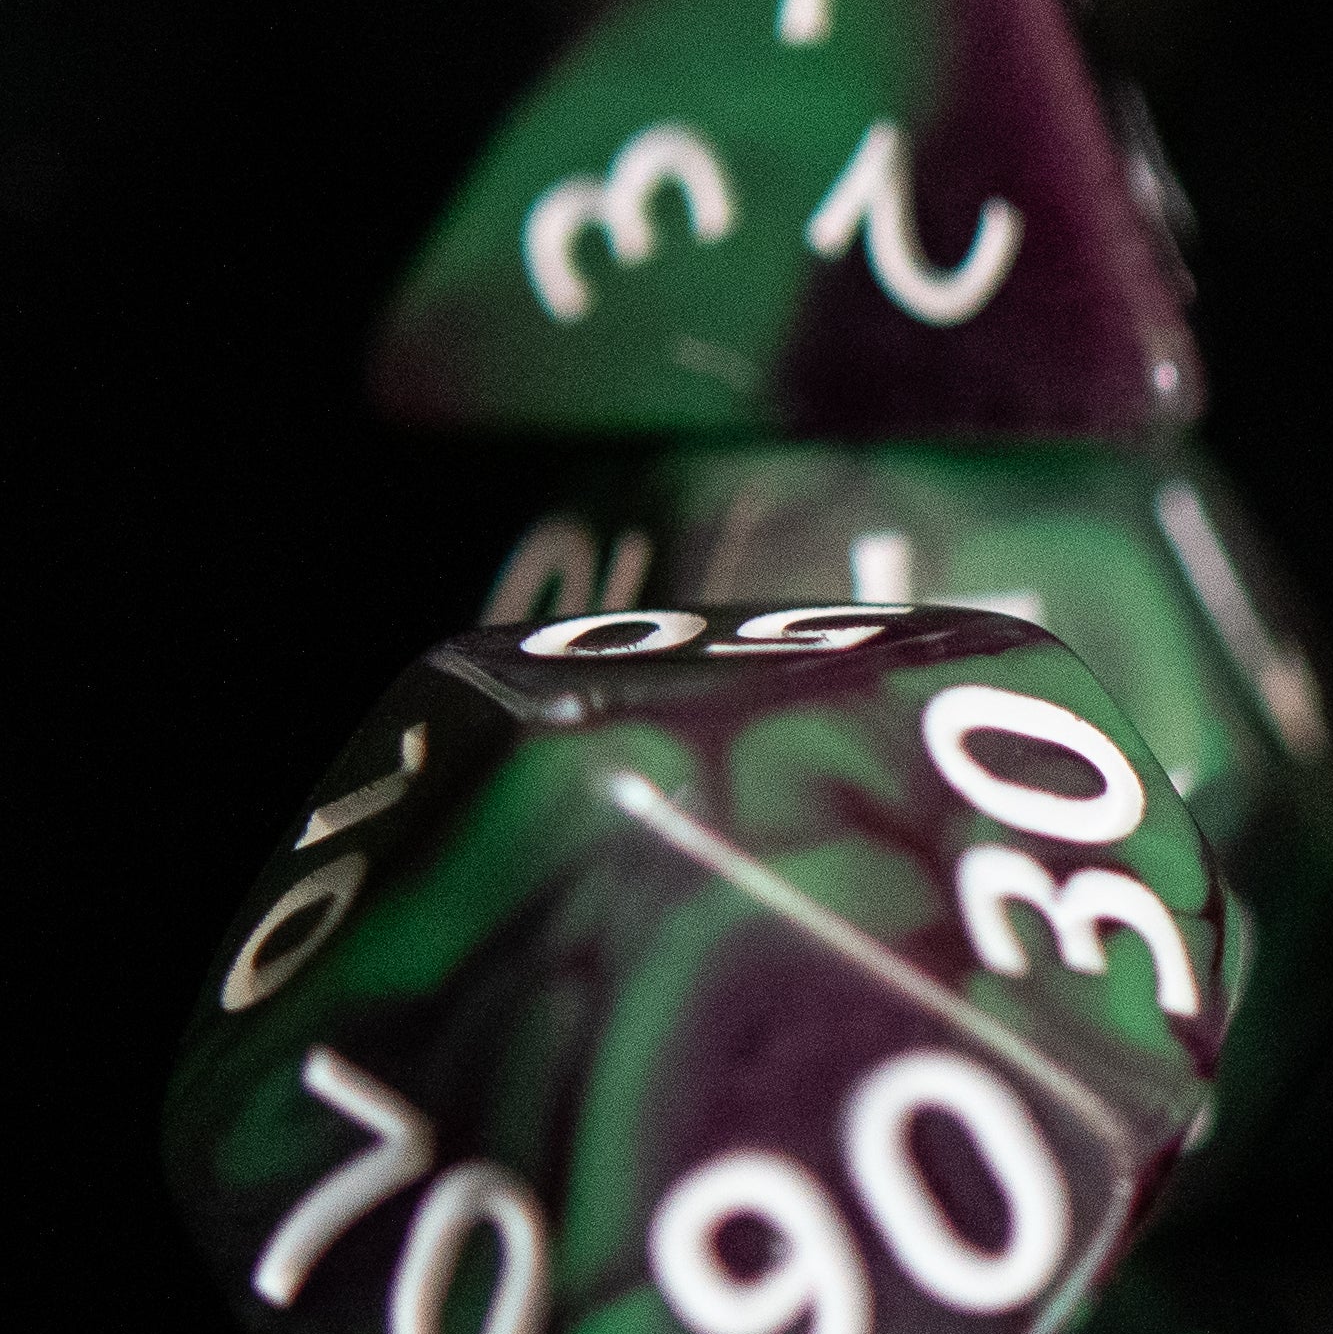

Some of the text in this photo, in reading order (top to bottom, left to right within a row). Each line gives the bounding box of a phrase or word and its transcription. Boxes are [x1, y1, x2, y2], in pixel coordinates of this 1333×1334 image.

[522, 121, 739, 323] 3
[803, 118, 1021, 327] 2
[922, 683, 1198, 1017] 30
